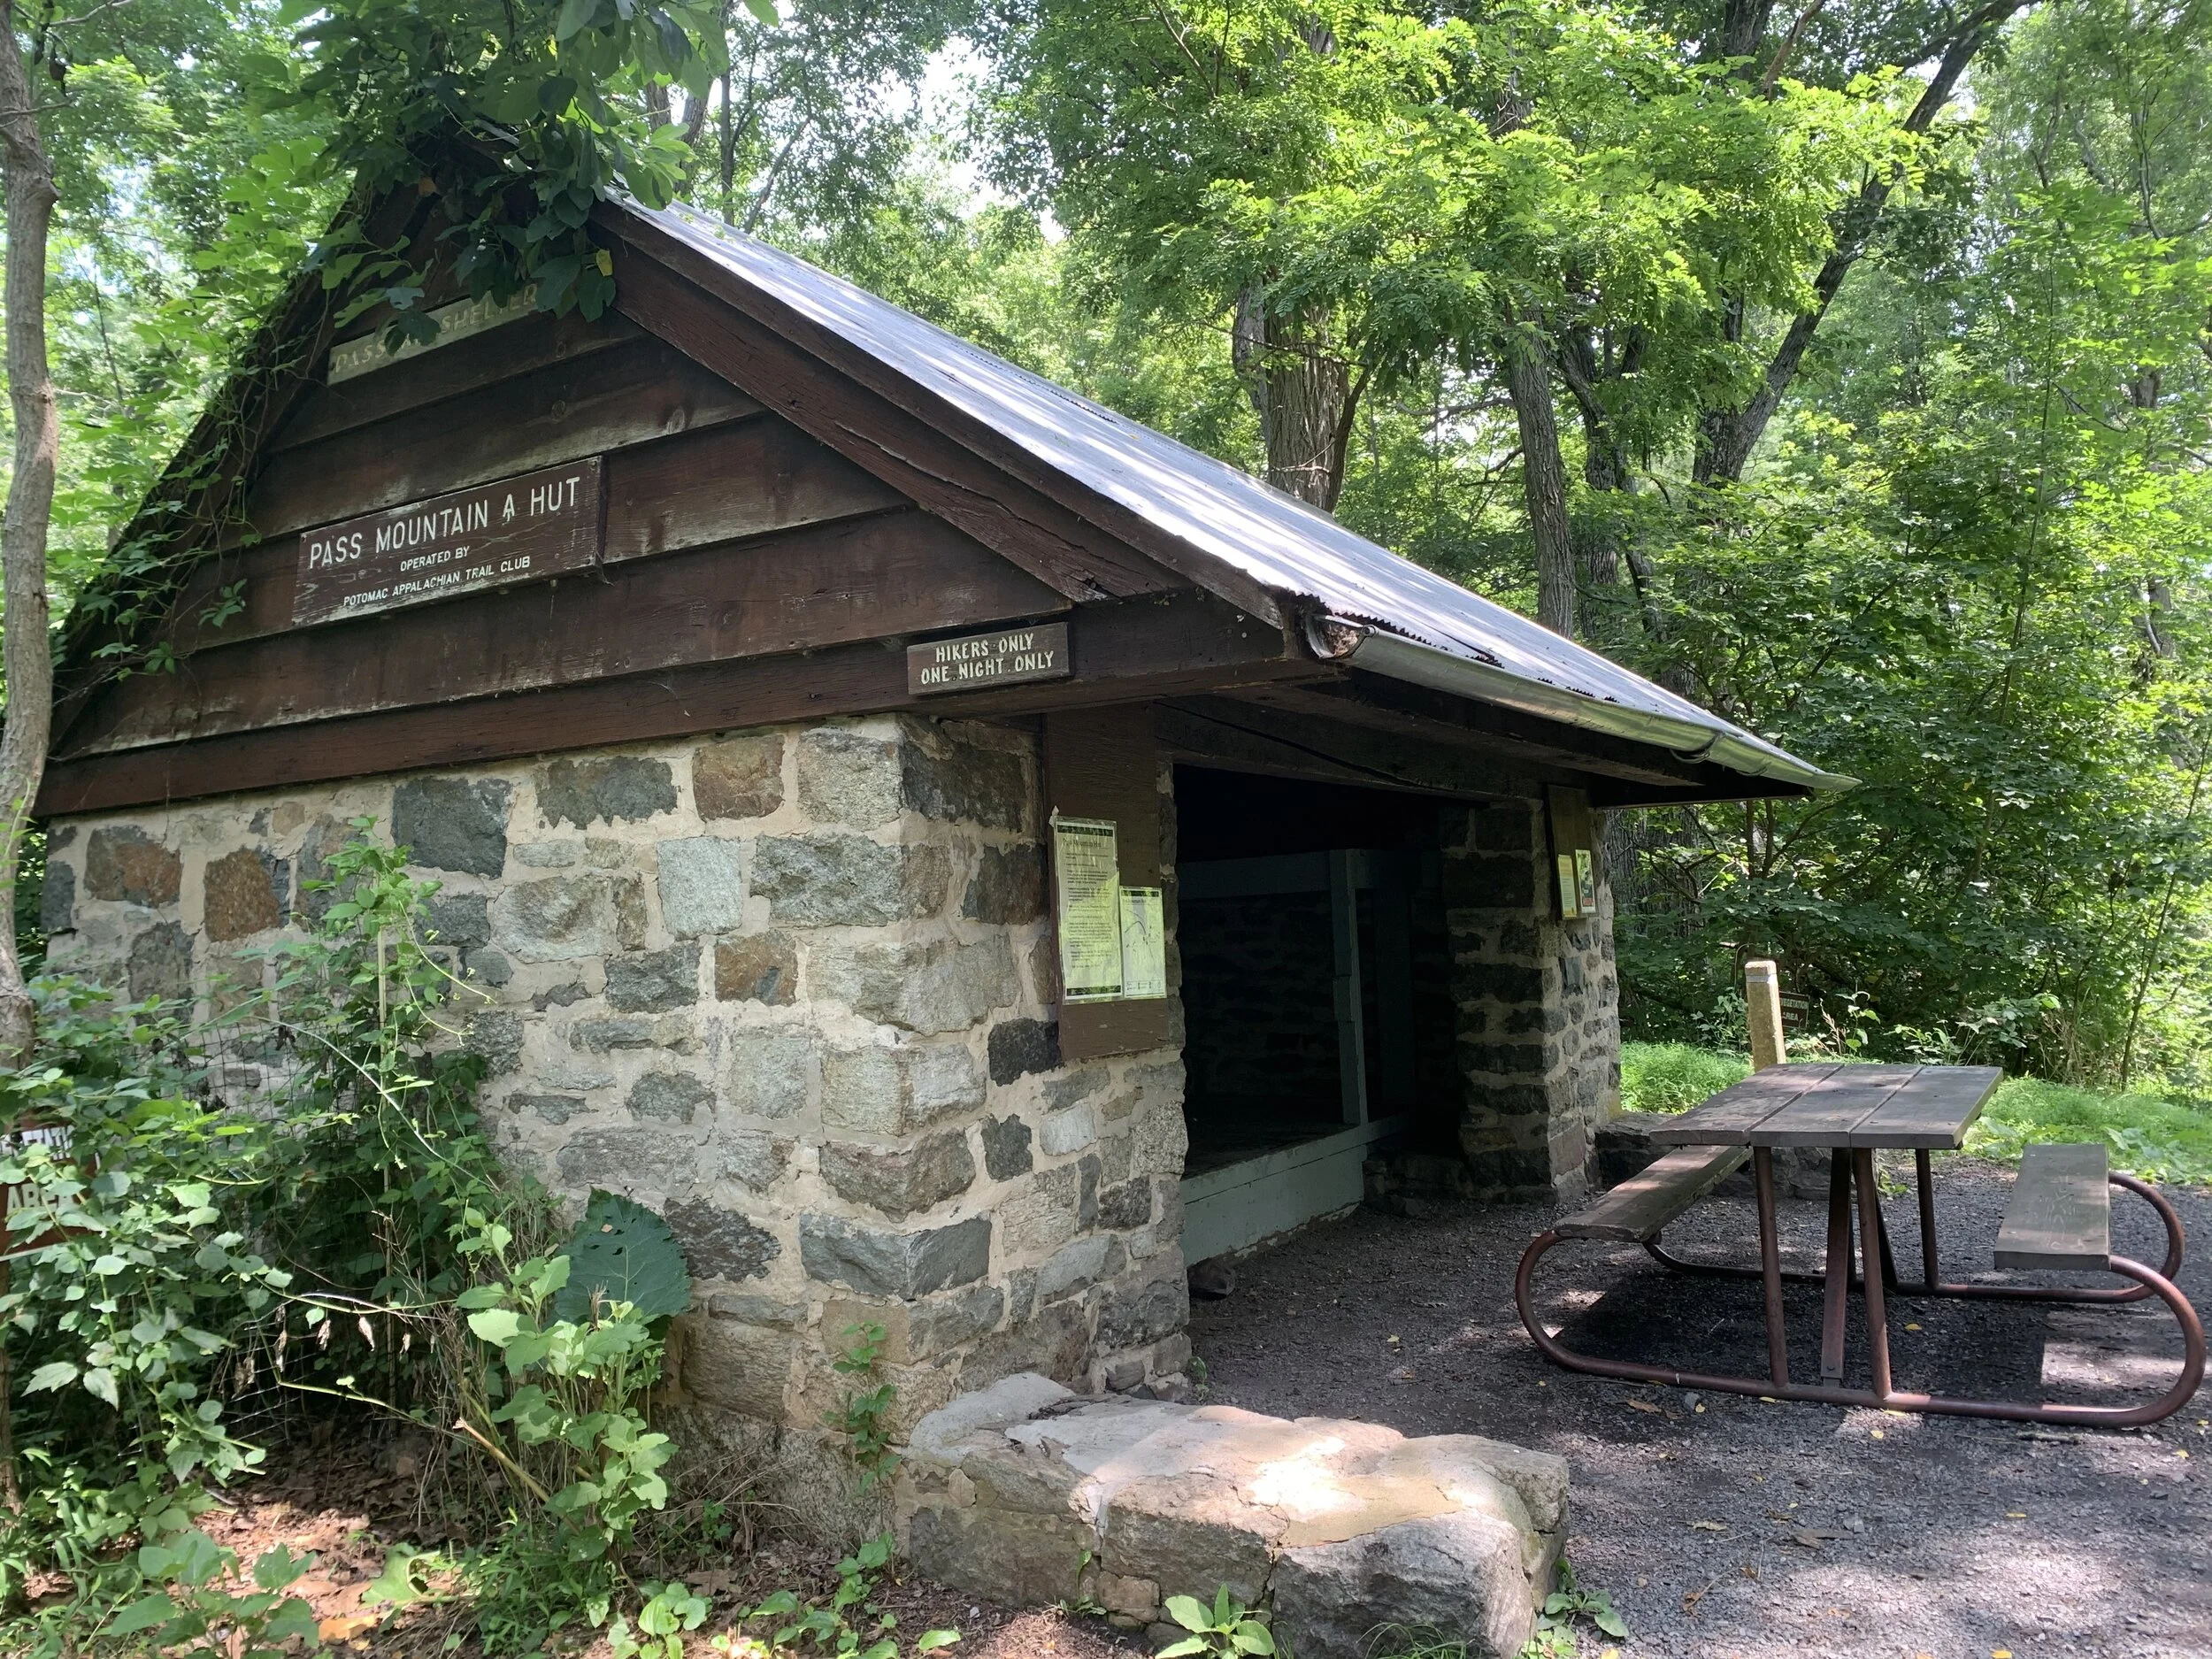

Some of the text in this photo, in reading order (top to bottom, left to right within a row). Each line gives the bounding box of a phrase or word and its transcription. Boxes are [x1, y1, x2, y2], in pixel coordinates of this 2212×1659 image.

[441, 283, 539, 334] SHELER
[310, 476, 580, 570] PASS MOUNTAIN A HUT
[400, 545, 471, 572] OPERATED BY
[343, 556, 531, 607] POTOMAC APPALACHIAN TRAIL CLUB
[921, 650, 1055, 686] ONE NIGHT ONLY
[935, 633, 1034, 664] HIKERS ONLY
